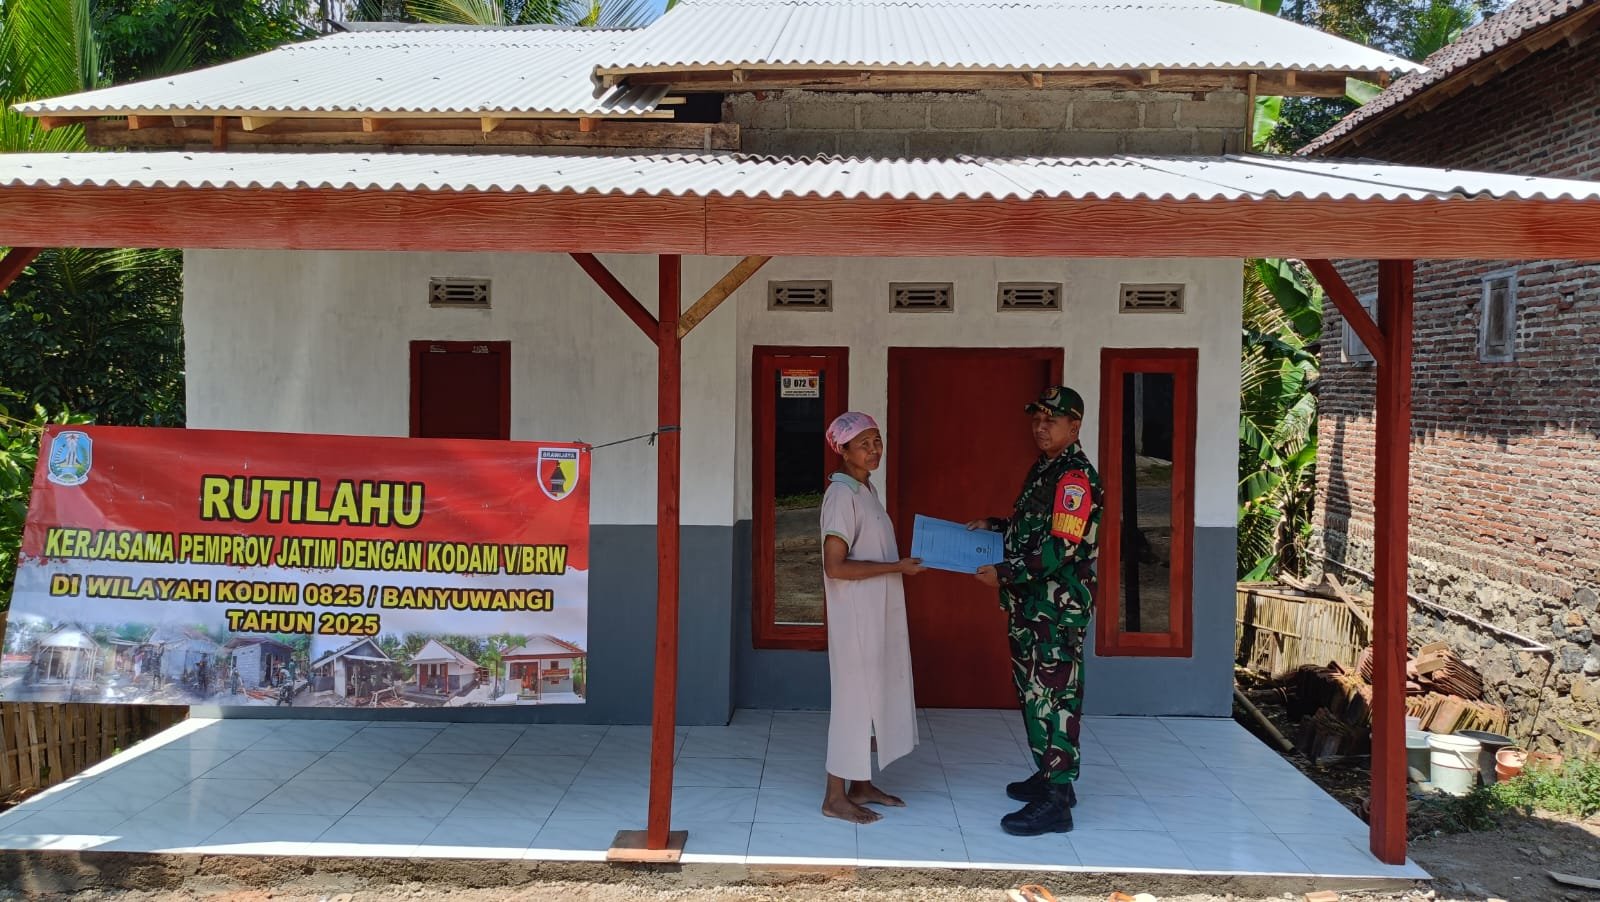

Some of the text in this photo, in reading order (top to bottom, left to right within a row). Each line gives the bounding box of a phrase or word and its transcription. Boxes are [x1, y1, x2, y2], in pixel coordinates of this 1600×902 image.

[794, 379, 807, 388] 072
[201, 477, 424, 526] RUTILAHU
[45, 528, 567, 574] KERJASAMA PEMPROV JATIM DENGAN KODAM V/BRW
[52, 575, 553, 610] DI WILAYAH KODIM 0825 / BANYUWANGI
[227, 610, 380, 634] TAHUN 2025
